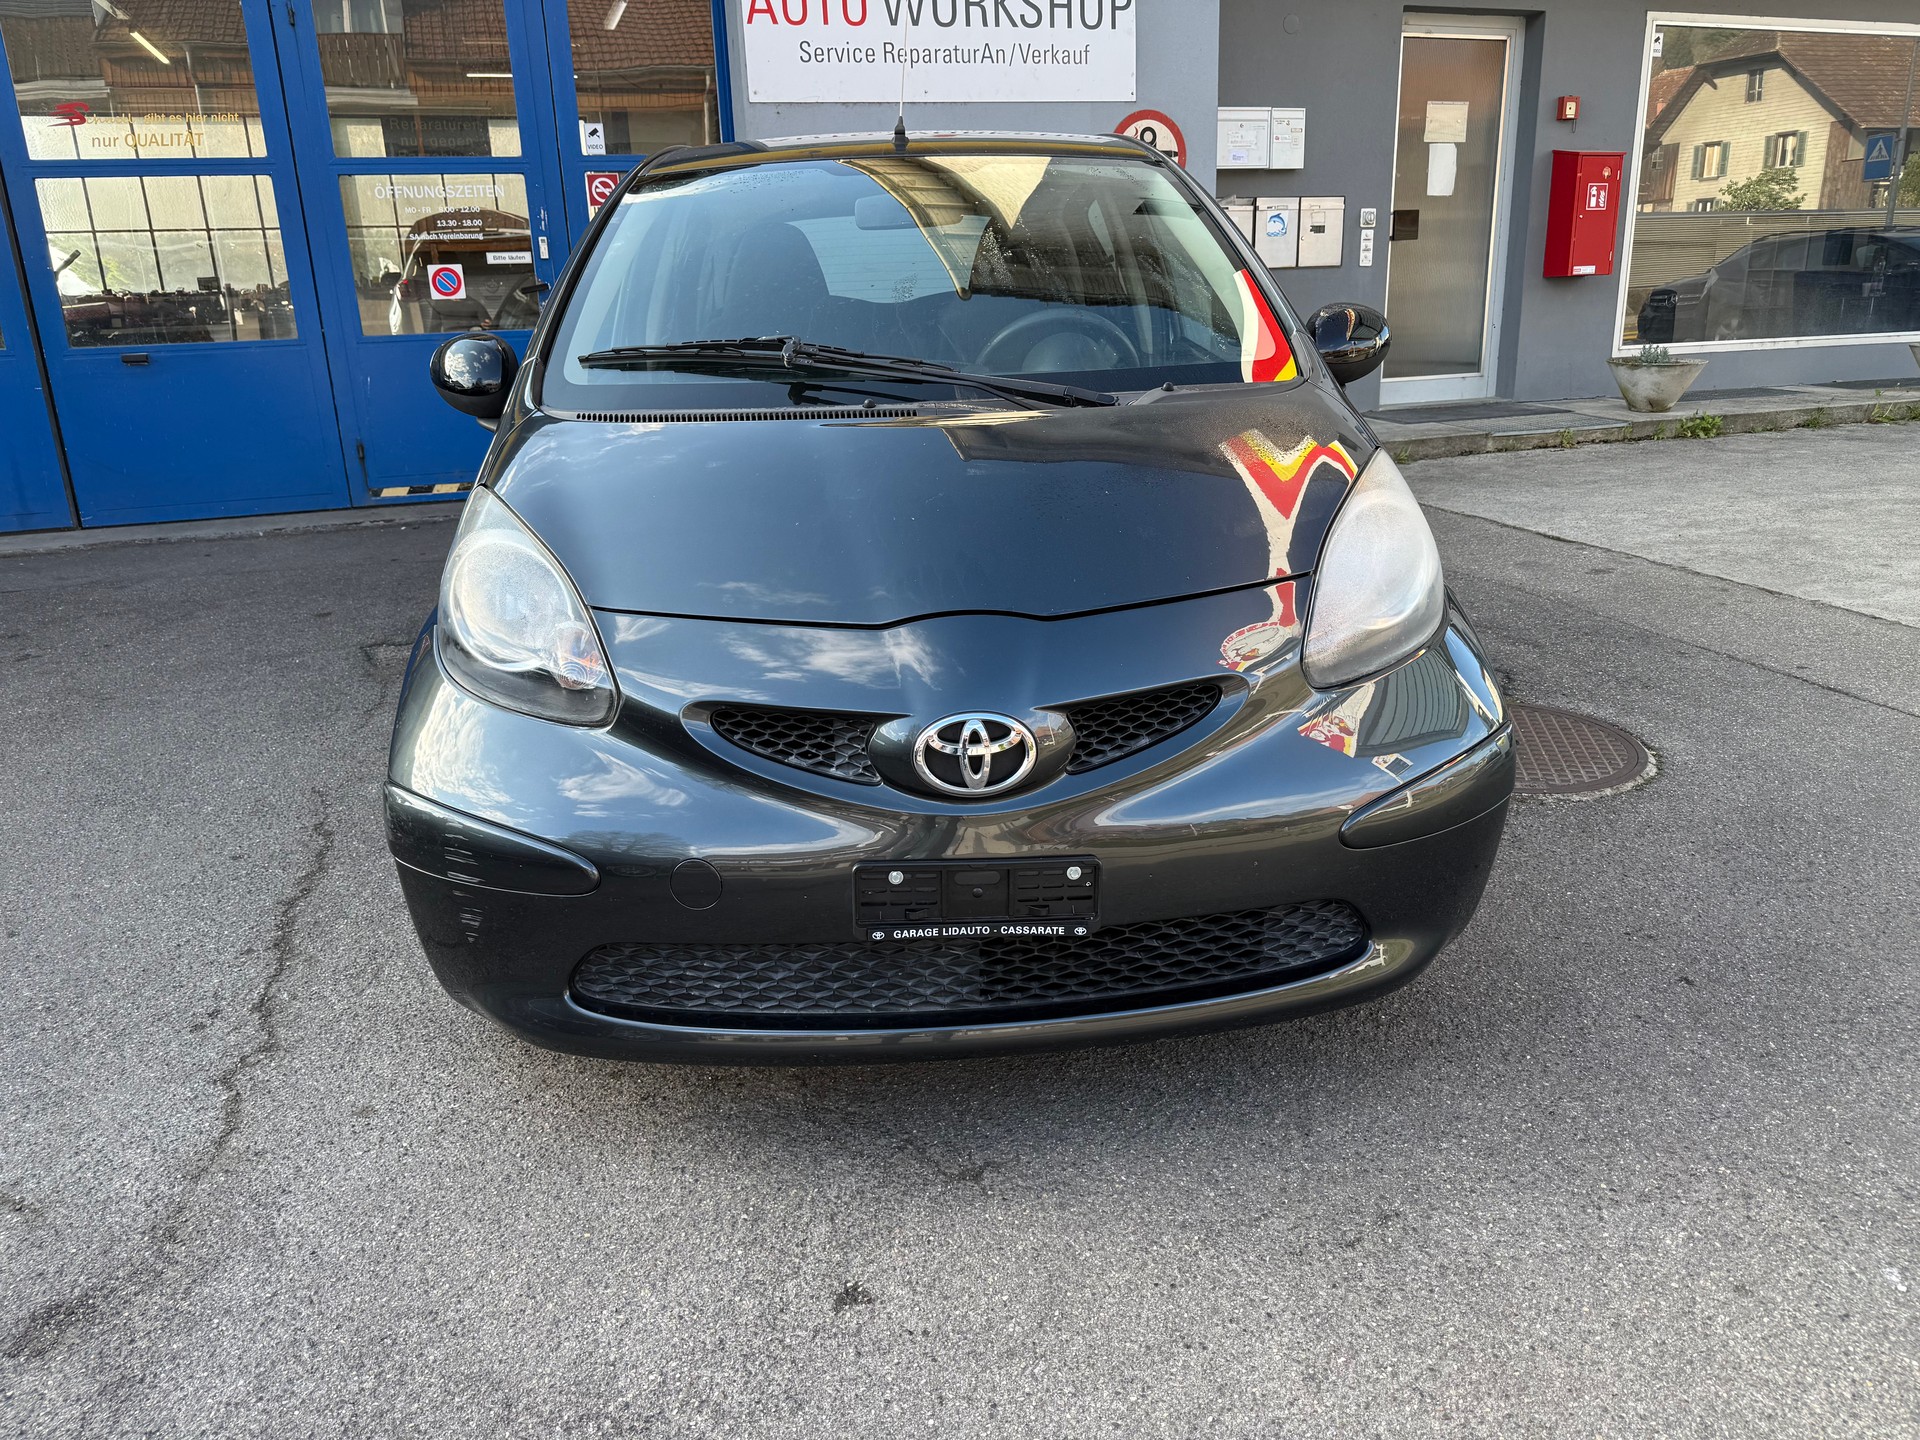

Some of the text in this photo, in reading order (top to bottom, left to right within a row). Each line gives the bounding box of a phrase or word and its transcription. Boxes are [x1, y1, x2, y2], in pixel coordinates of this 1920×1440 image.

[746, 0, 1132, 30] AUTO WORKSHOP
[799, 40, 1091, 69] Service ReparaturAn/Verkauf
[143, 113, 166, 125] gibt
[168, 114, 182, 123] es
[185, 112, 208, 123] hier
[210, 112, 240, 123] nicht
[91, 130, 204, 149] nur QUALITÄT
[374, 183, 506, 199] ÖFFNUNGSZEITEN
[404, 206, 417, 214] MO
[422, 206, 432, 214] FR
[460, 205, 480, 213] 12.00
[436, 219, 457, 227] 13.30
[462, 219, 483, 227] 18.00
[438, 232, 484, 240] Vereinbarung
[893, 928, 939, 939] GARAGE
[942, 926, 990, 936] LIDAUTO
[1000, 926, 1065, 935] CASSARATE
